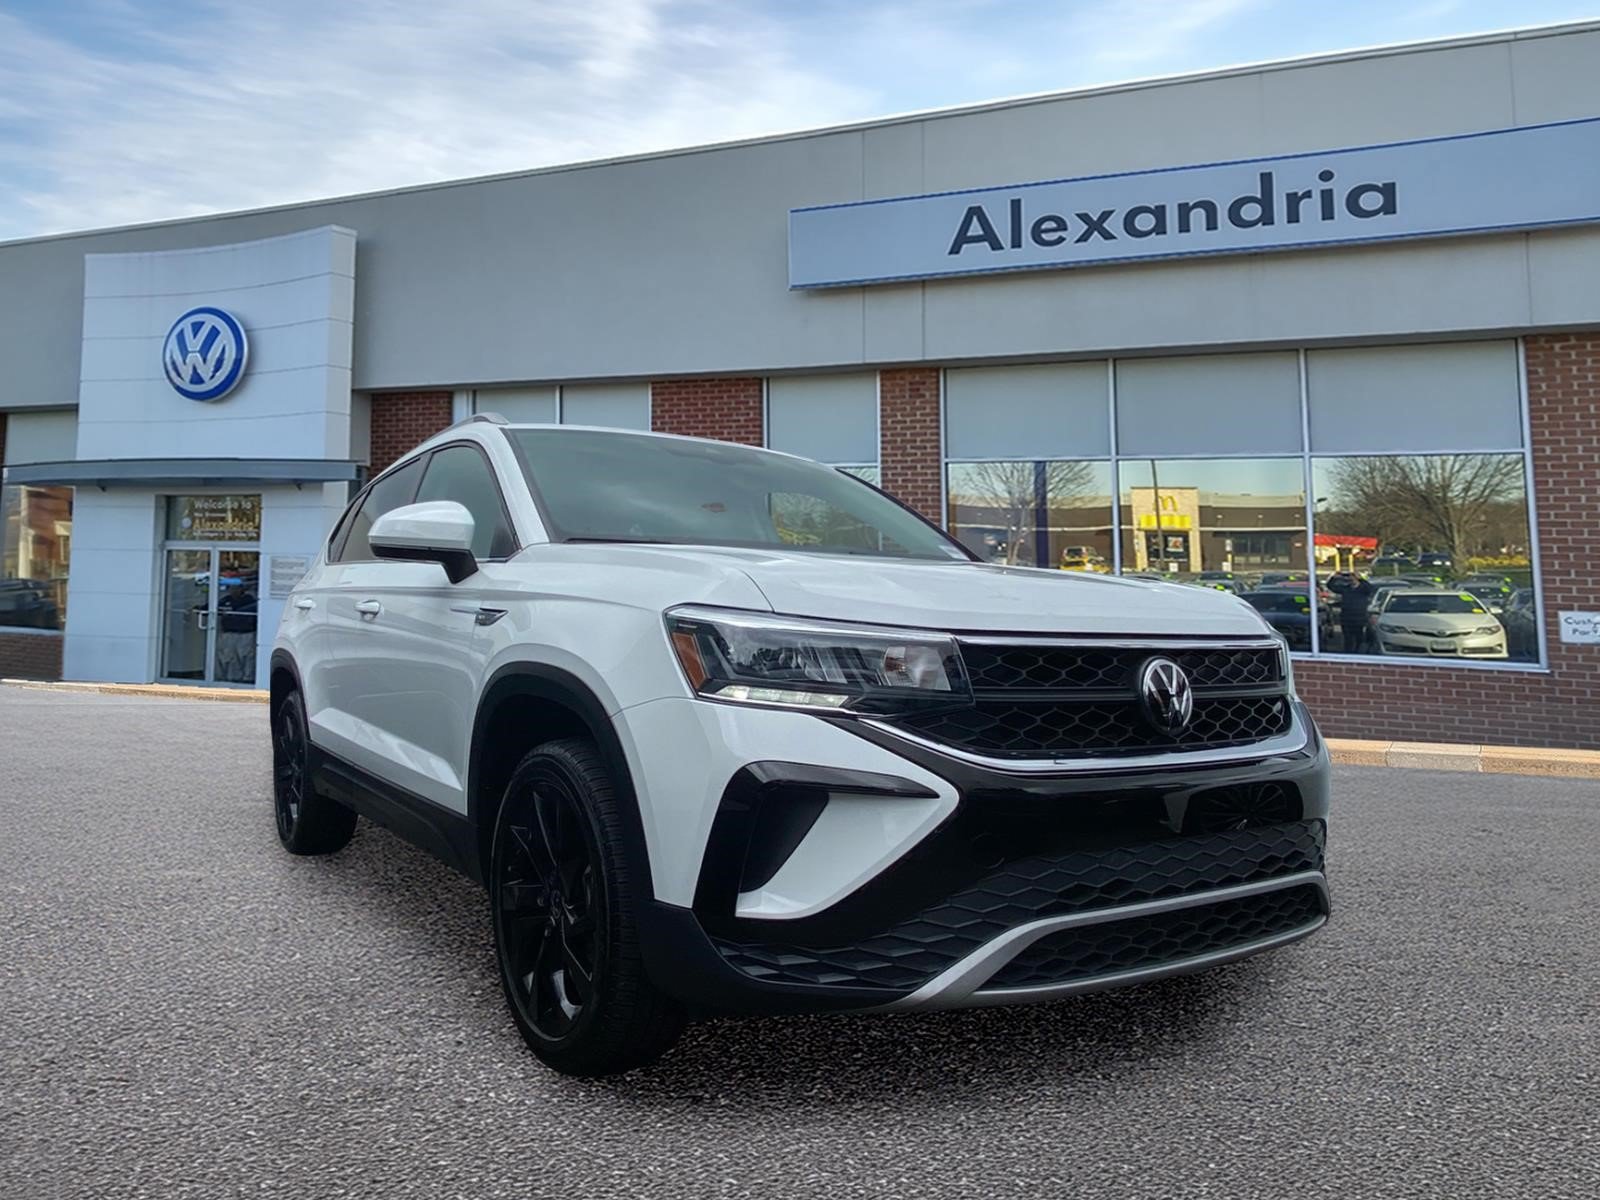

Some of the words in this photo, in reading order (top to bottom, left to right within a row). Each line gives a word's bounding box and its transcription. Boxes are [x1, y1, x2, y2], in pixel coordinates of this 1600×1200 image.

[948, 169, 1398, 256] Alexandria
[193, 499, 239, 509] Welcome
[241, 499, 252, 509] to
